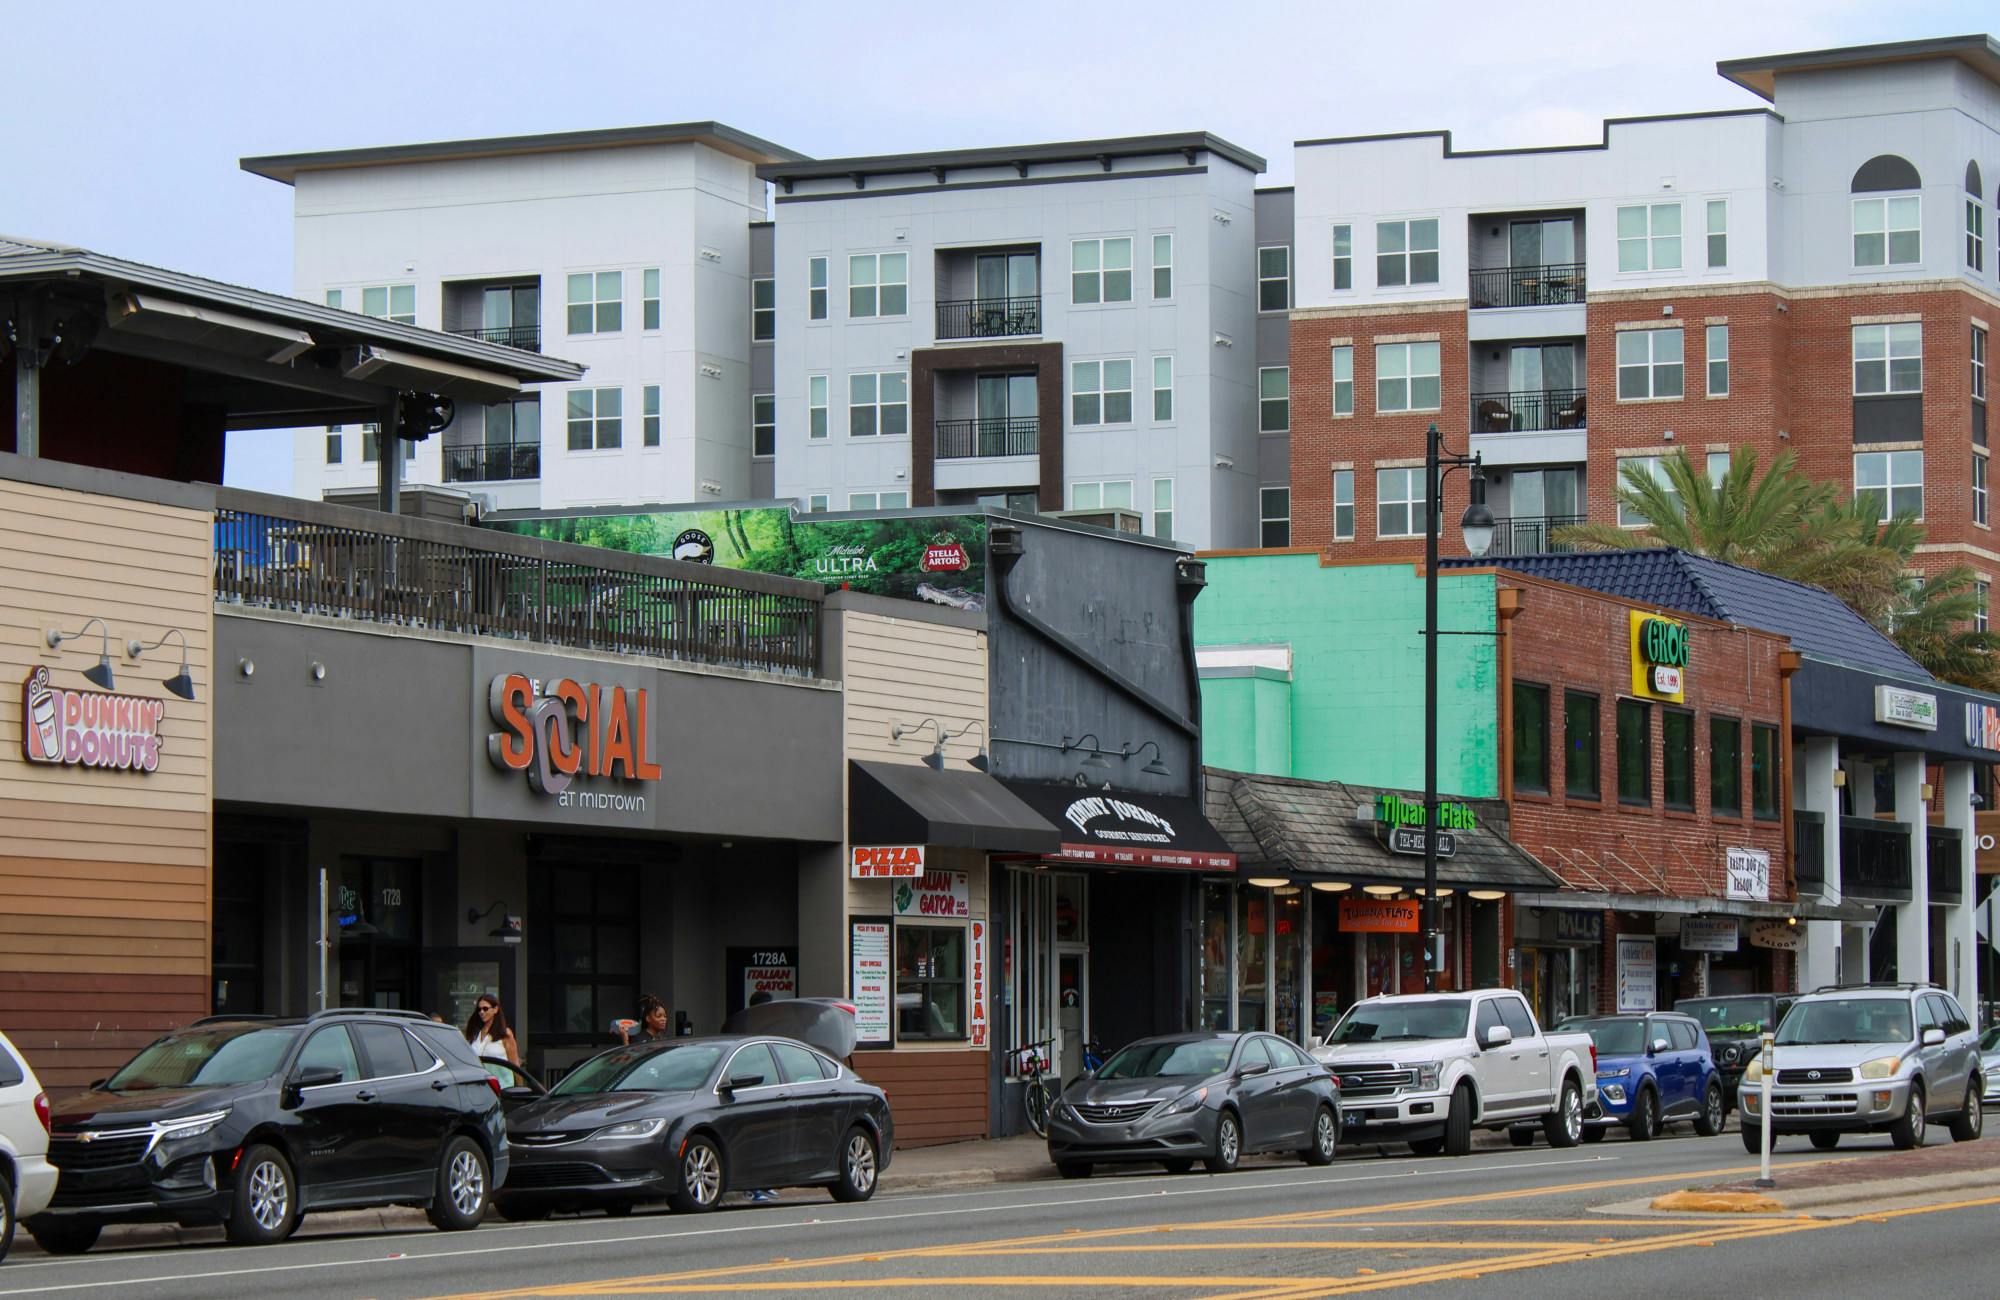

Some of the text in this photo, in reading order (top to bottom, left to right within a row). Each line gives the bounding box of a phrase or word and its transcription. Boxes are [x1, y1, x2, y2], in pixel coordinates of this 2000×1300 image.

[680, 532, 706, 543] GOOSE
[824, 543, 866, 556] Michelob
[928, 549, 960, 558] STELLA
[816, 555, 877, 574] ULTRA
[928, 557, 961, 566] ARTOIS
[1647, 618, 1690, 668] GROG
[65, 690, 163, 736] DUNKIN'
[65, 729, 159, 771] DONUTS
[1065, 796, 1176, 837] JIMMY JOHN'S
[1382, 795, 1477, 830] Tijuan Flats
[1438, 836, 1450, 851] ALL
[854, 847, 922, 866] PIZZA
[859, 865, 916, 876] BY THE SLICE
[382, 888, 401, 906] 1728
[919, 894, 955, 915] GATOR
[1385, 907, 1414, 920] FLATS
[1558, 911, 1601, 937] BALLS
[1760, 936, 1797, 947] SALOON
[752, 952, 787, 965] 1728A
[747, 969, 791, 980] ITALIAN
[974, 922, 984, 1019] PIZZA
[755, 981, 794, 992] GATOR
